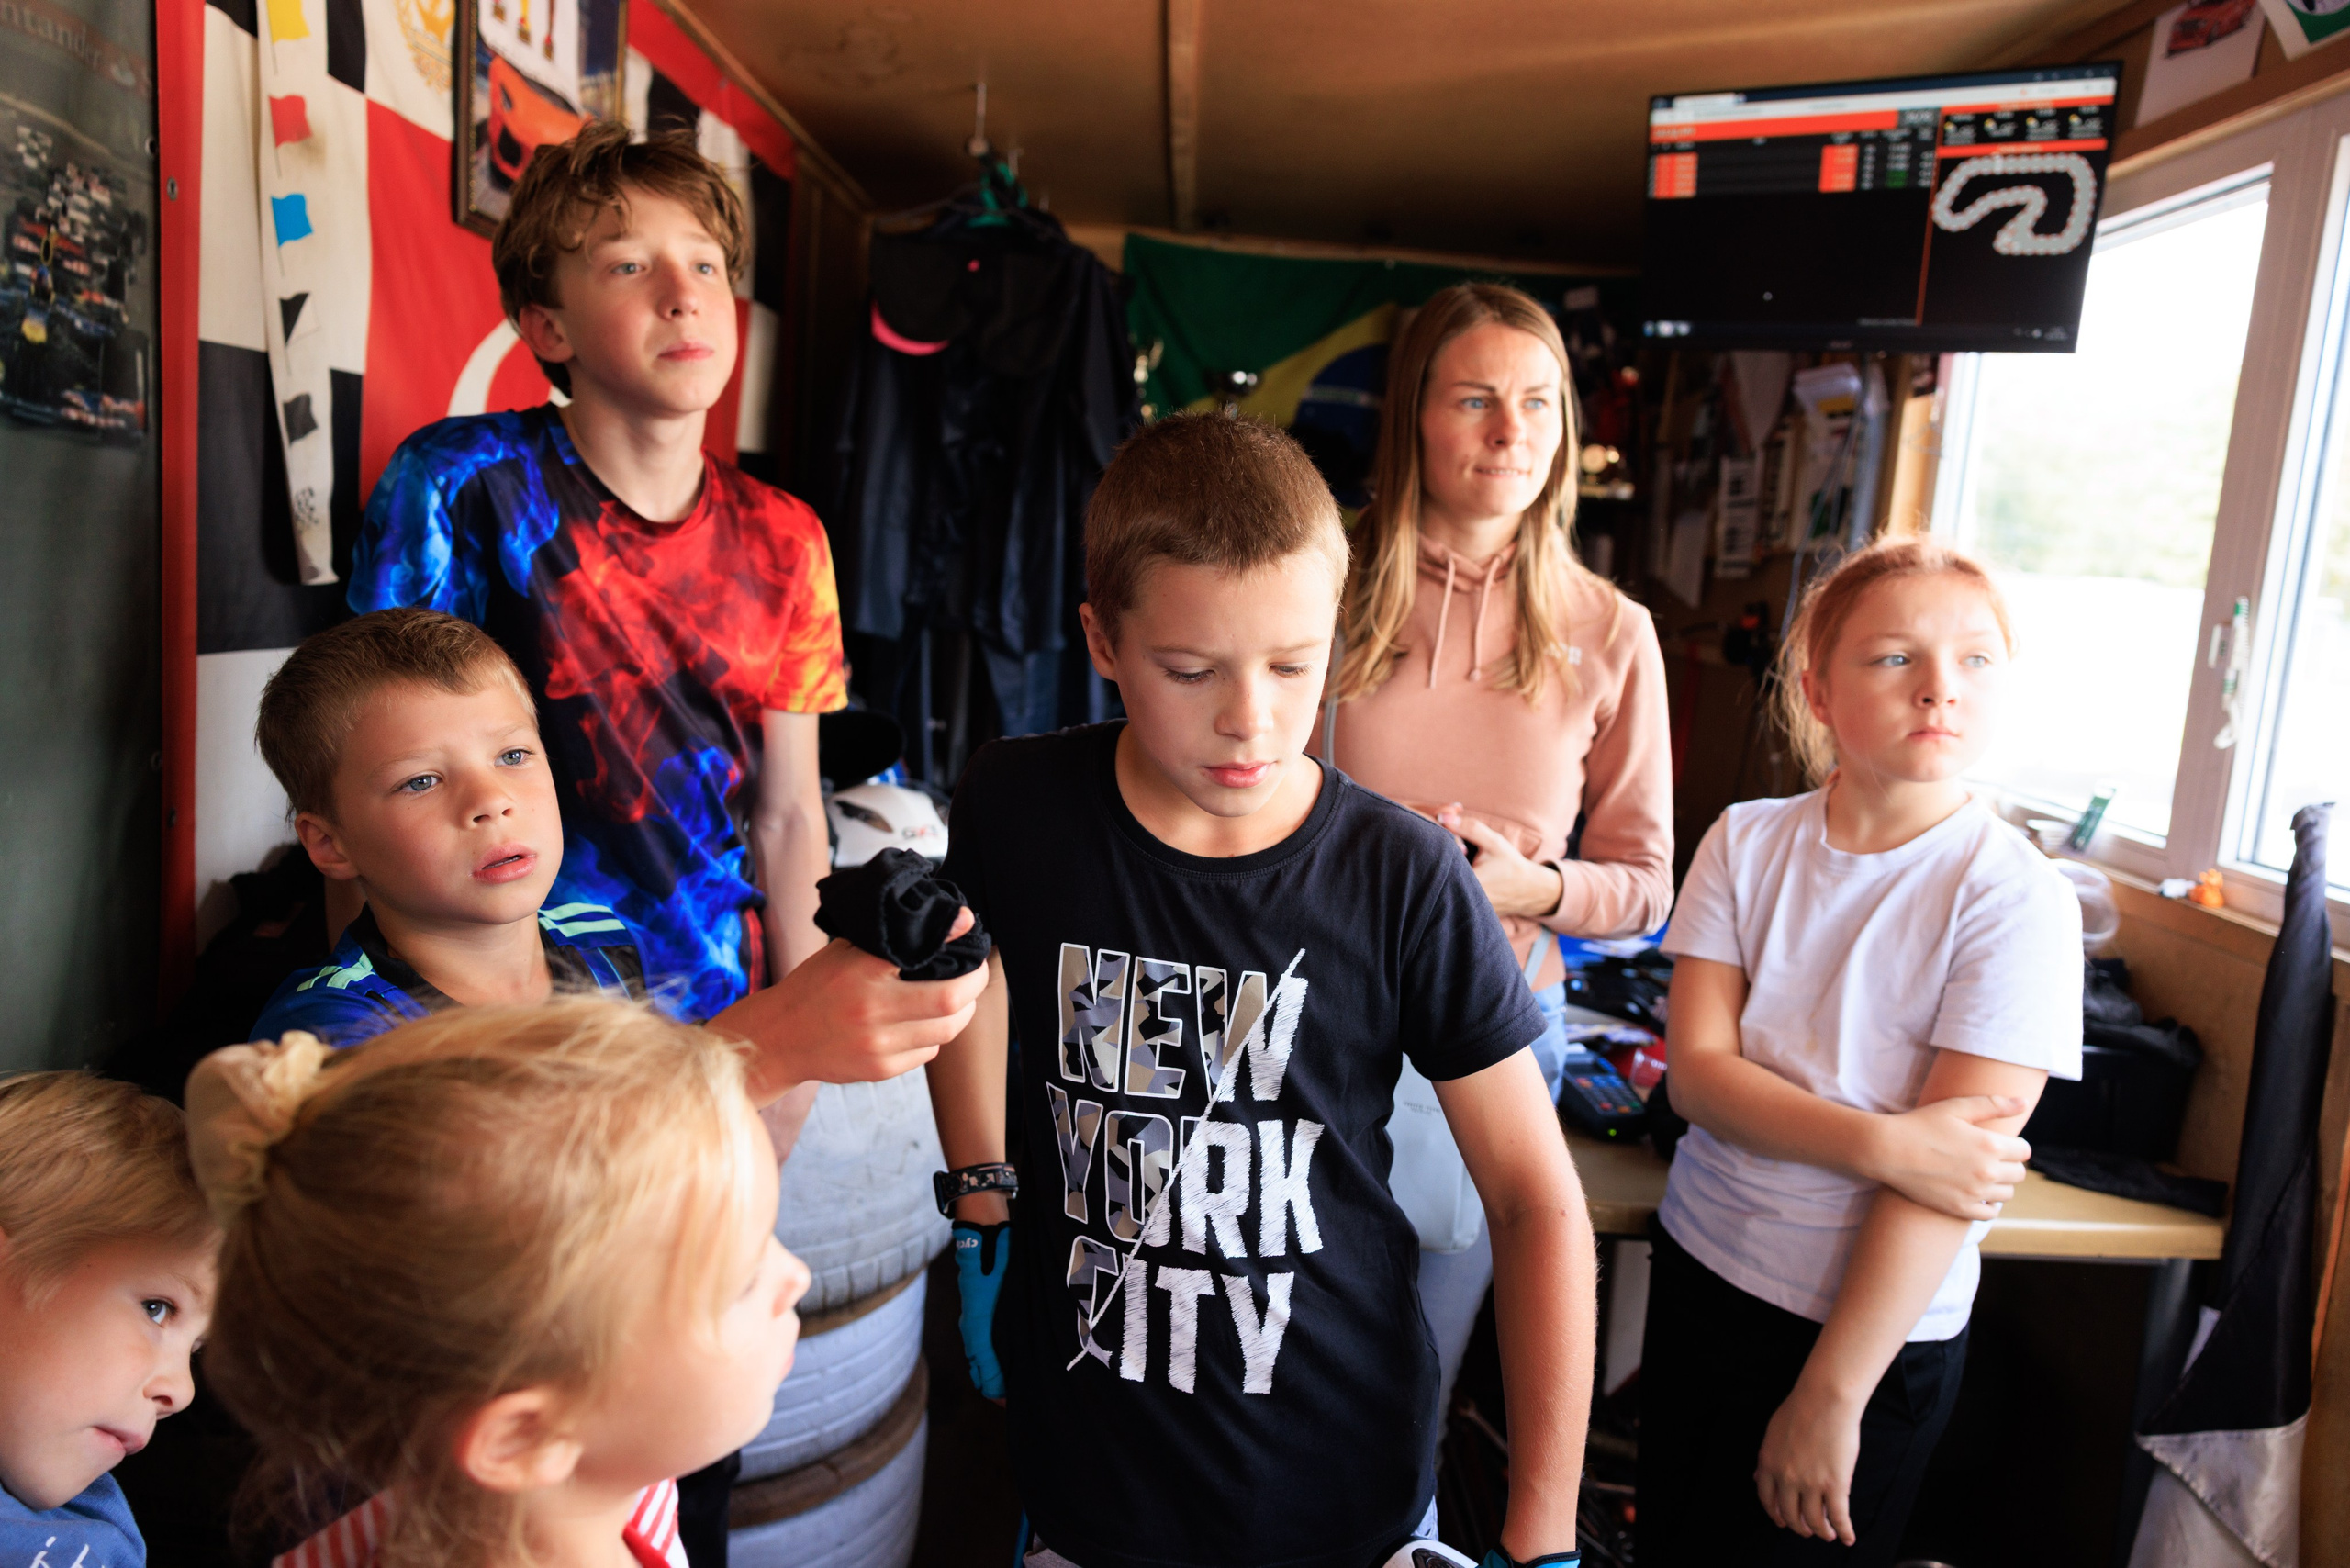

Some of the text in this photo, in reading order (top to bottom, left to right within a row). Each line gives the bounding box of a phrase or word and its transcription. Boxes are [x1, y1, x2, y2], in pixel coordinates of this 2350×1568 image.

[1058, 942, 1308, 1103] NEW
[1046, 1081, 1325, 1259] YORK
[1066, 1235, 1295, 1395] CITY
